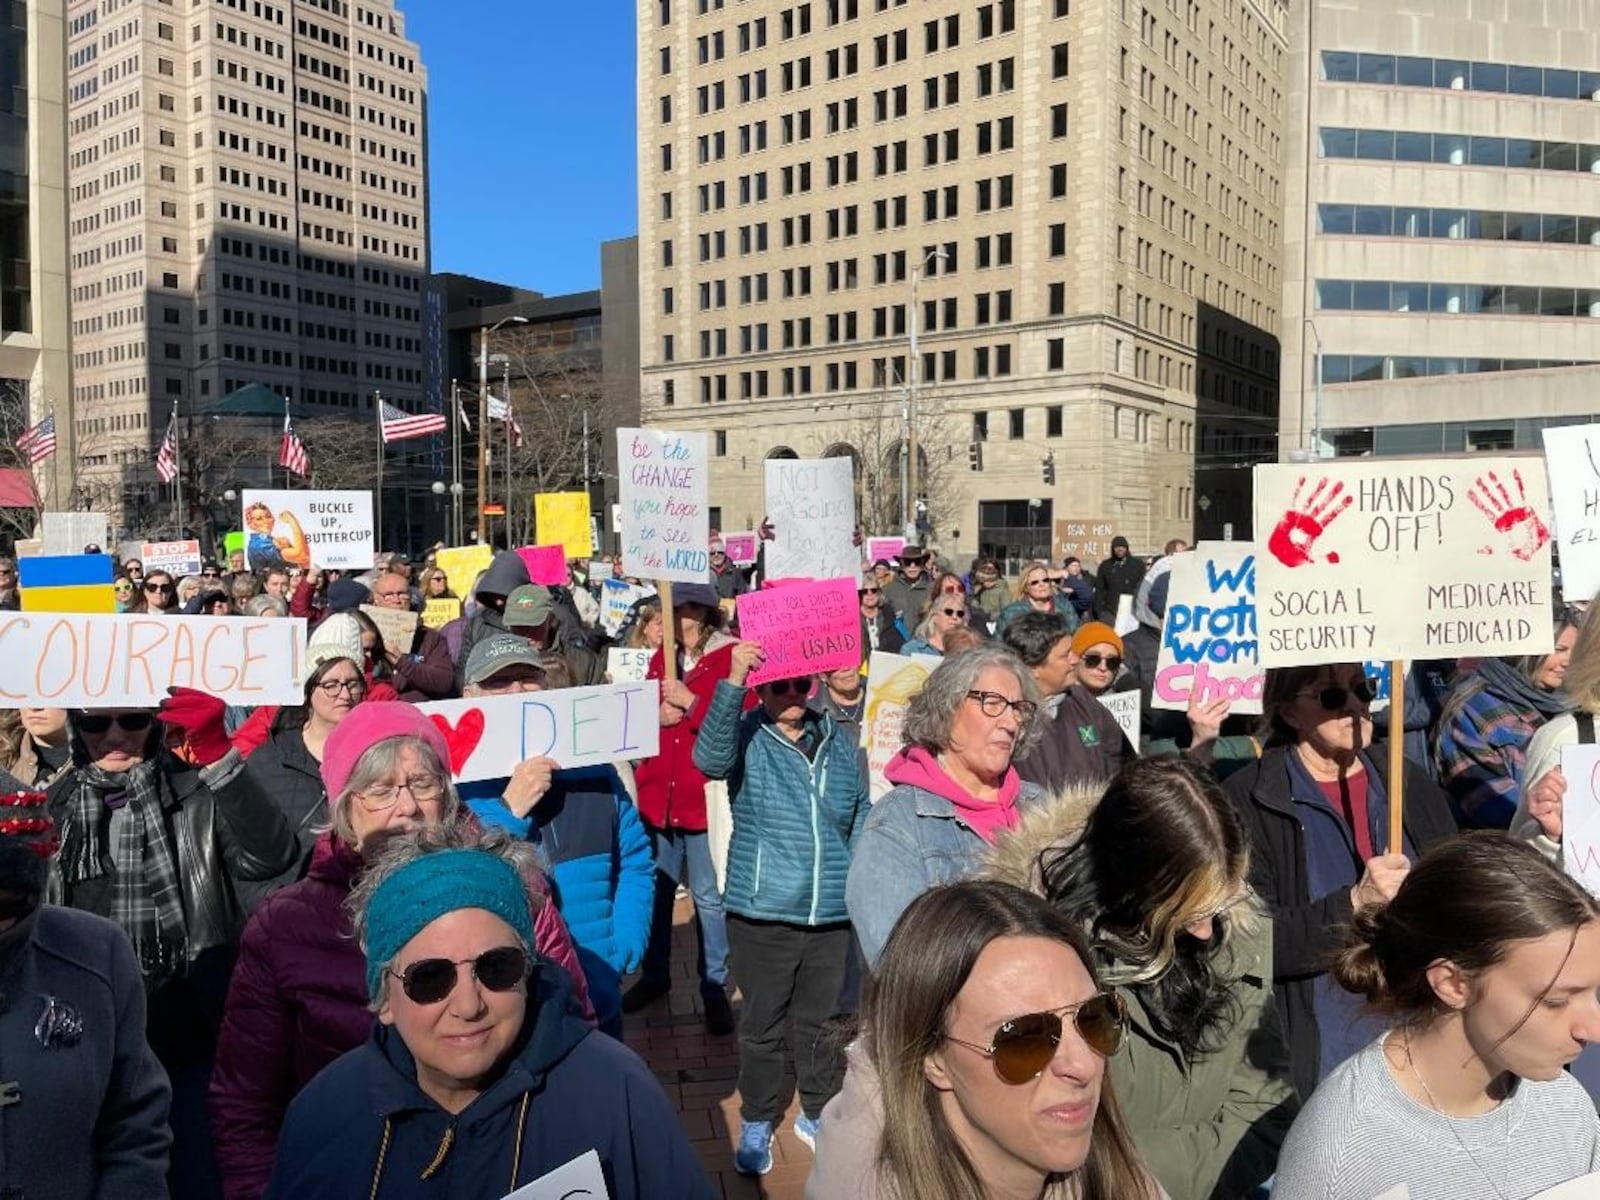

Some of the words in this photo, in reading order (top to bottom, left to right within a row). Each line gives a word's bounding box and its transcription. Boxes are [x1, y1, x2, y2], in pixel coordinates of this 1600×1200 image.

[630, 436, 652, 458] be
[662, 438, 691, 461] the
[632, 463, 695, 489] CHANGE
[778, 464, 819, 492] NOT
[1359, 475, 1454, 512] HANDS
[310, 503, 354, 514] BUCKLE
[633, 497, 661, 519] you
[664, 495, 699, 523] hope
[305, 530, 372, 544] BUTTERCUP
[321, 518, 342, 530] UP,
[640, 526, 657, 540] to
[662, 527, 690, 543] see
[1368, 513, 1443, 552] OFF!
[152, 543, 189, 555] STOP
[642, 552, 662, 569] the
[666, 547, 707, 573] WORLD
[1269, 588, 1373, 617] SOCIAL
[1427, 580, 1544, 611] MEDICARE
[1269, 624, 1376, 651] SECURITY
[1426, 618, 1531, 646] MEDICAID
[620, 652, 631, 666] I
[801, 632, 856, 660] USAID
[521, 688, 643, 762] DEI
